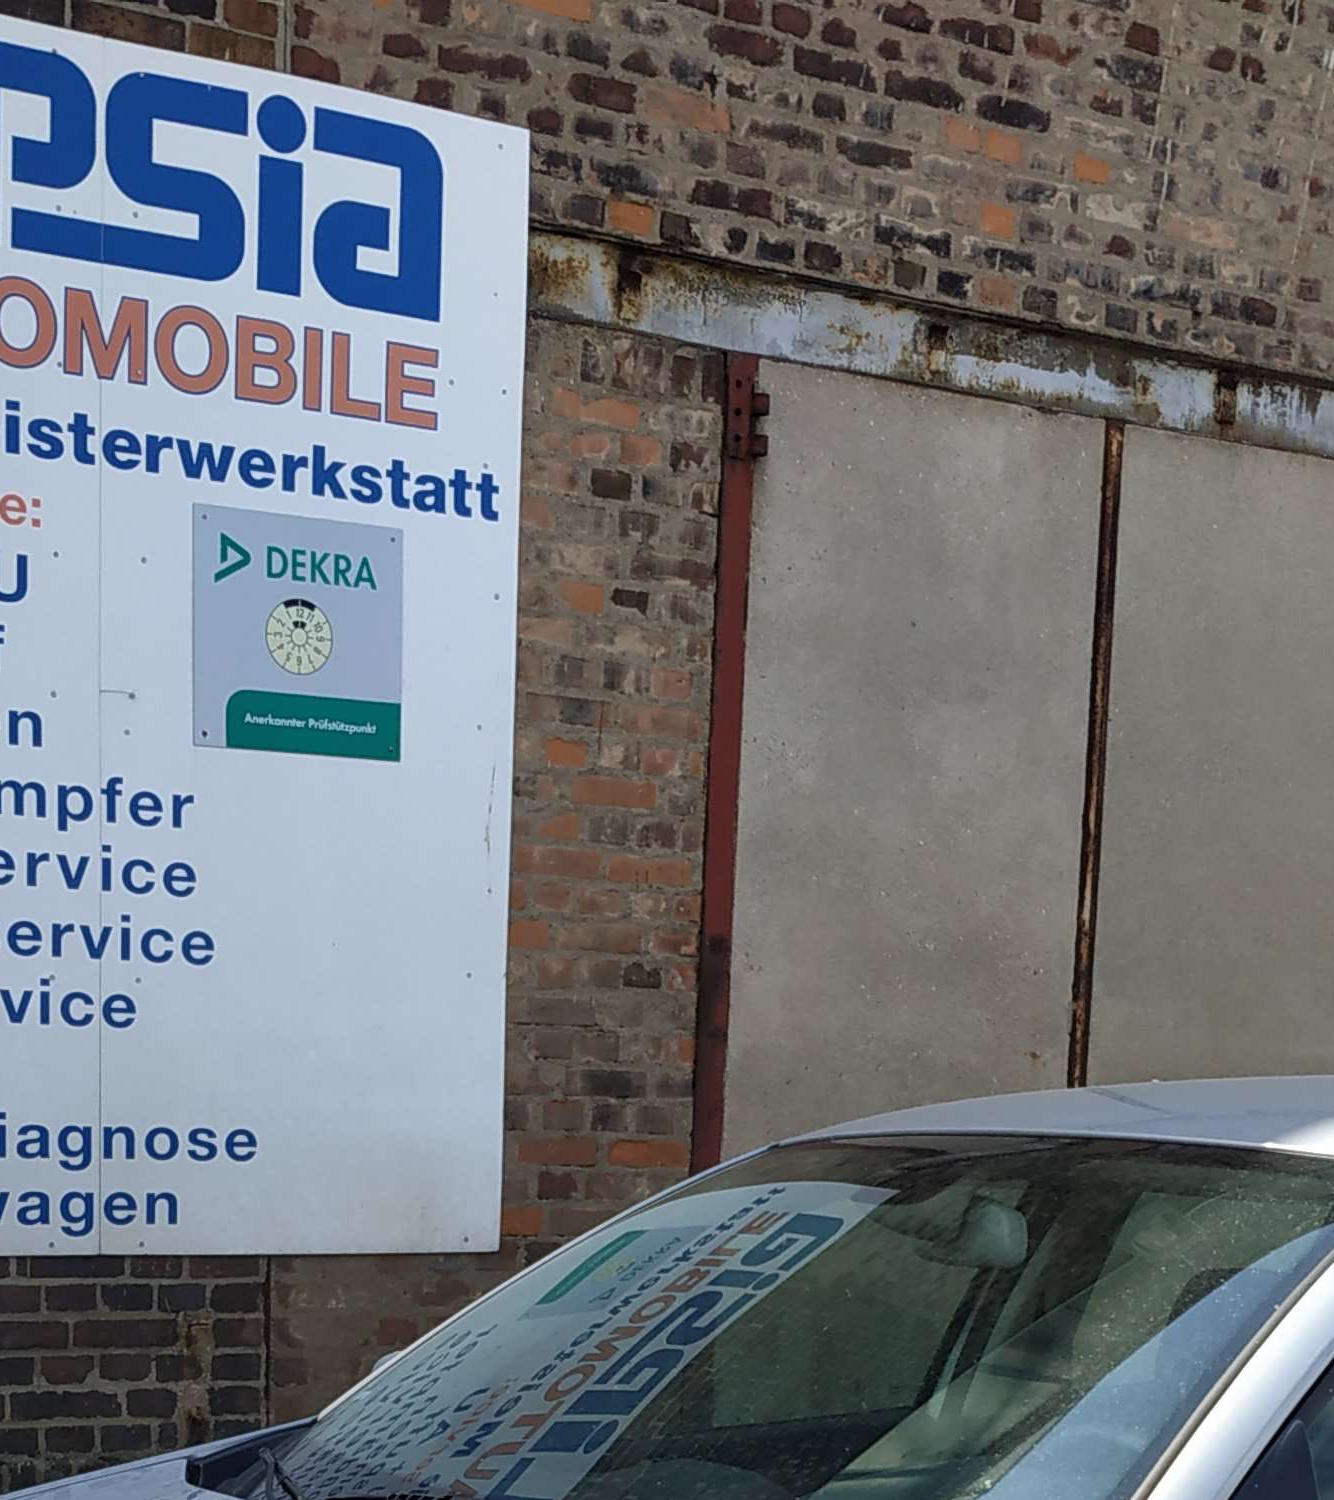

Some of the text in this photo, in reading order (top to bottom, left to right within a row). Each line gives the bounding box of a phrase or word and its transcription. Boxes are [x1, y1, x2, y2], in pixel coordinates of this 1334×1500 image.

[266, 545, 377, 590] DEKRA
[244, 712, 377, 736] Anerkannter Prüfstützpunkt
